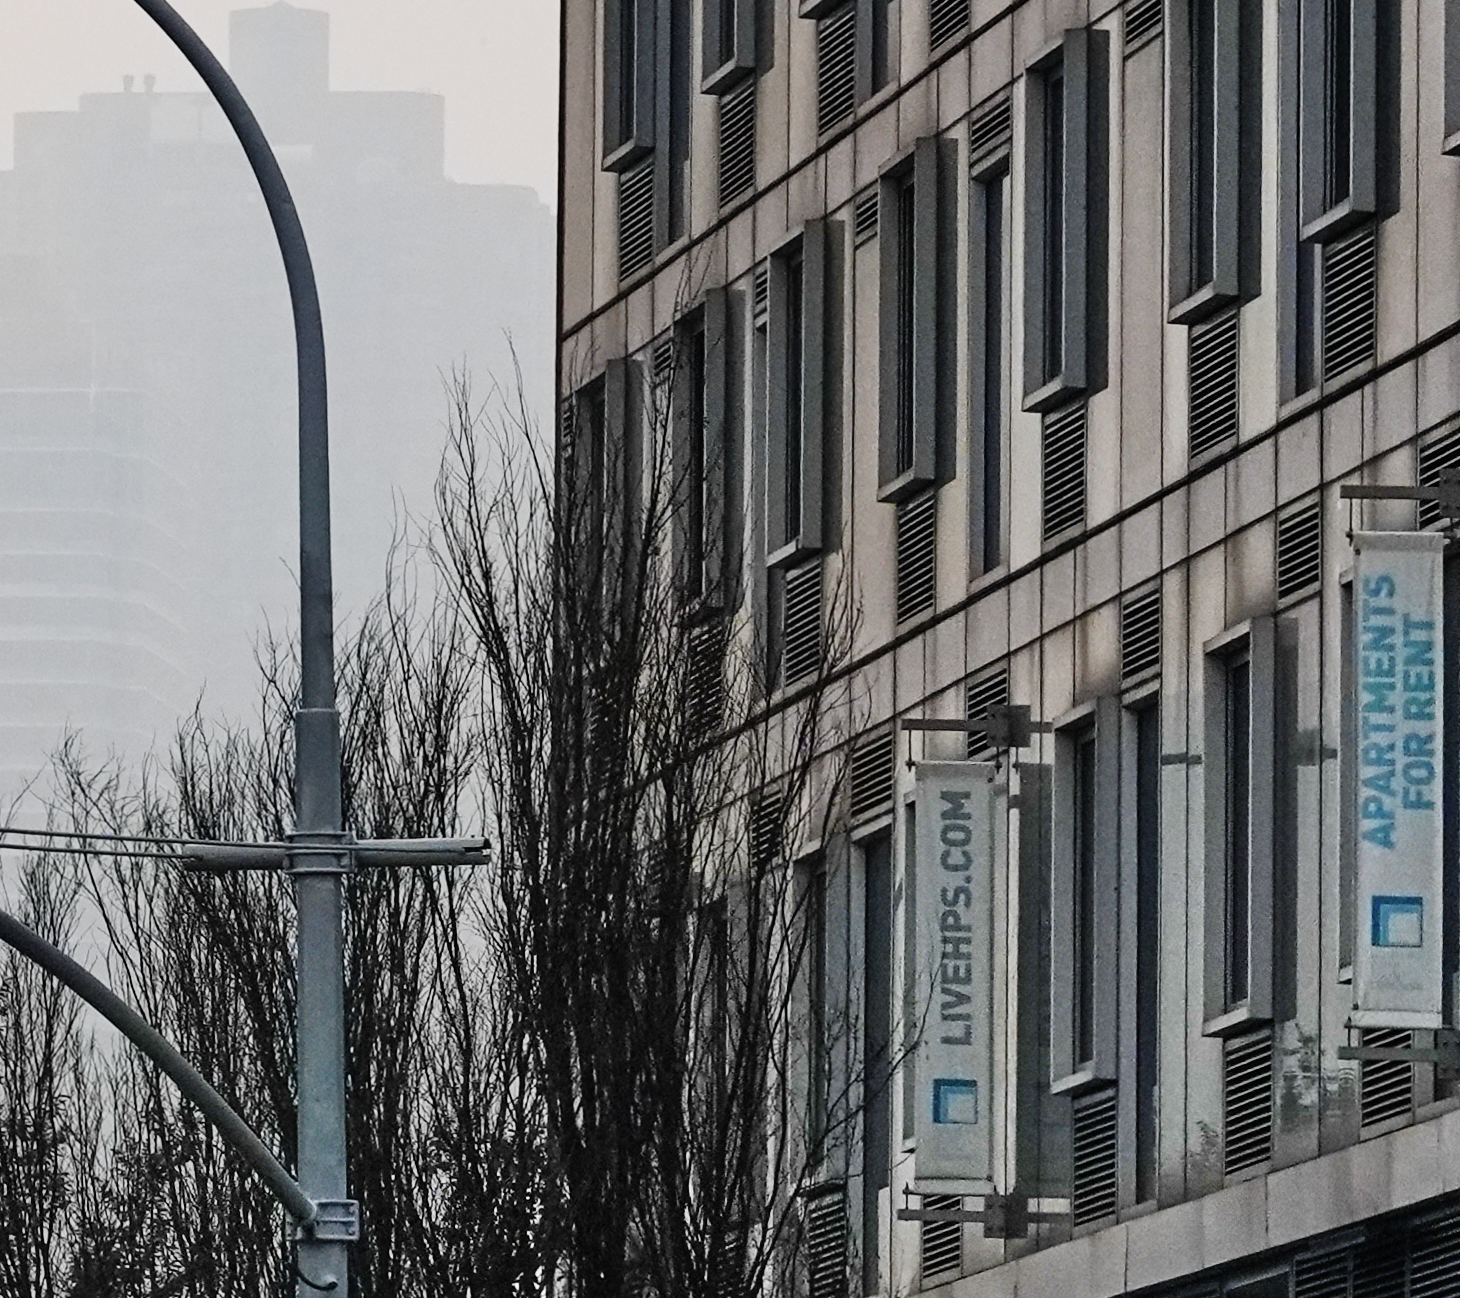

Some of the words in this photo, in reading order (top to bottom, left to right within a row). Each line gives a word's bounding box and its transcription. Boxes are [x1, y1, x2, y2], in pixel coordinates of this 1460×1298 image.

[1361, 574, 1396, 850] APARTMENTS
[1402, 614, 1436, 721] RENT
[1402, 732, 1436, 811] FOR
[940, 790, 973, 1046] LIVEHPS.COM
